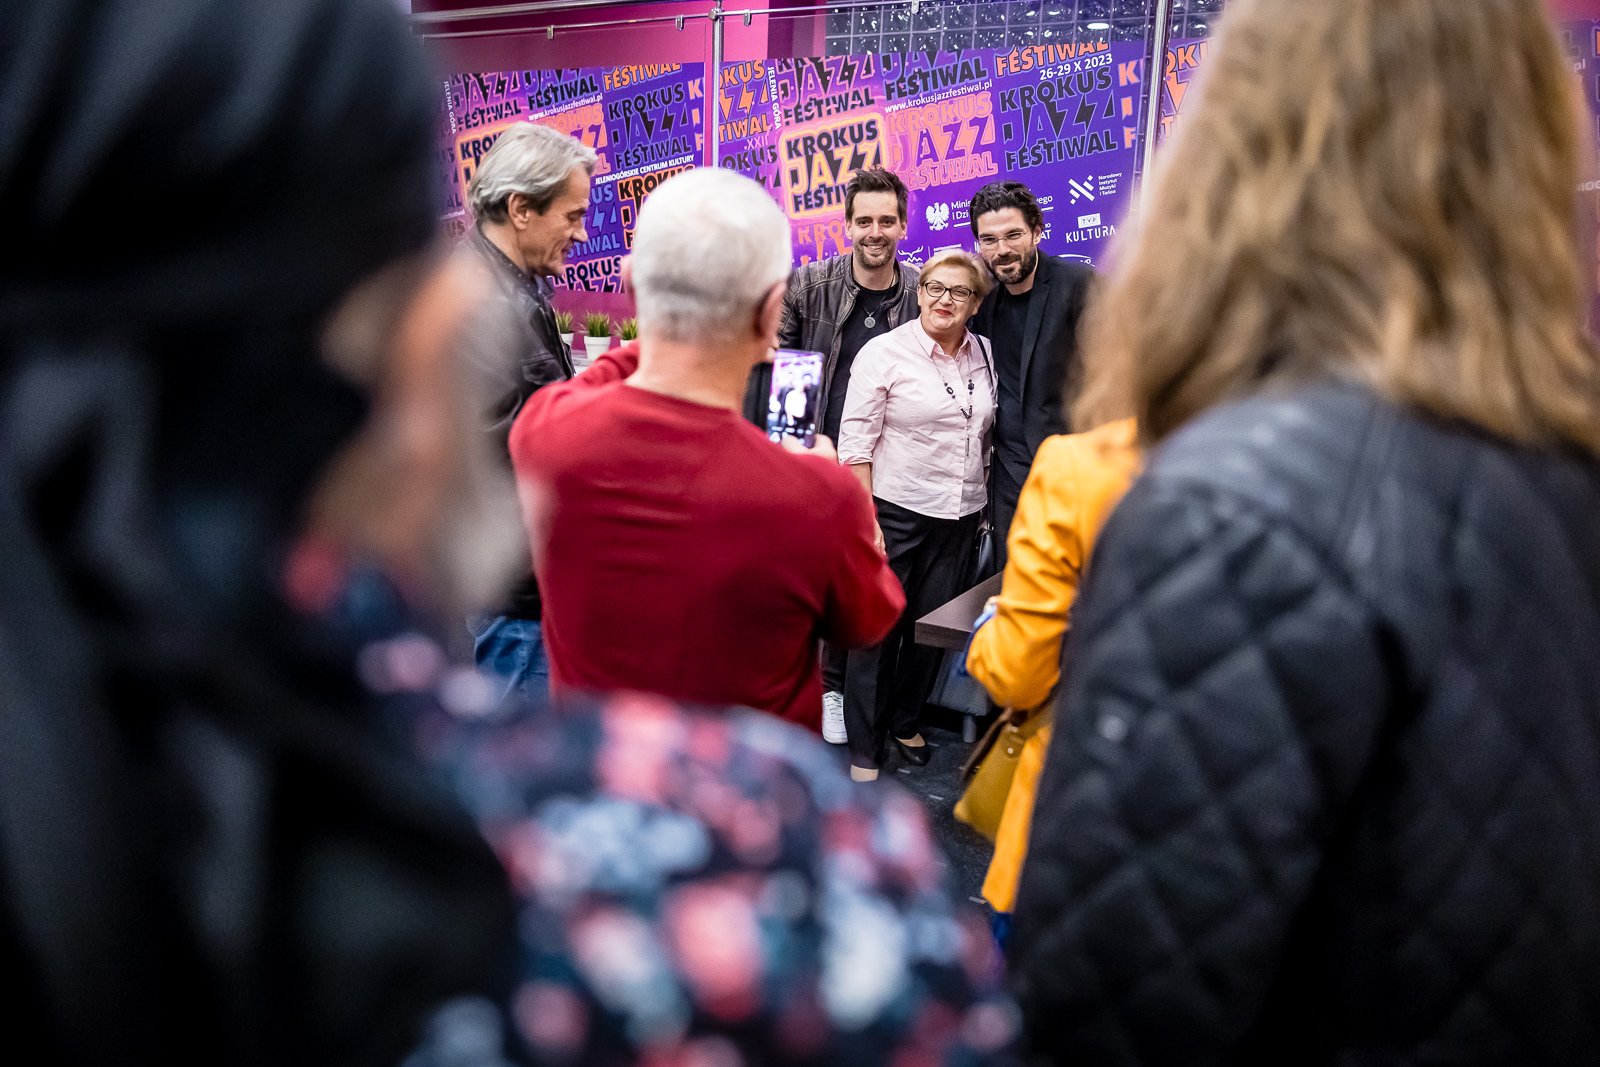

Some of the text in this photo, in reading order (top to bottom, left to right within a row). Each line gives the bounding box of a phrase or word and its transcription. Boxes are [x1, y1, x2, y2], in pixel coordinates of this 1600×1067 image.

[604, 63, 681, 91] FESTIWAL
[885, 57, 988, 102] FESTIWAL
[1040, 53, 1113, 80] 26-29 X 2023
[528, 76, 599, 111] FESTIWAL
[609, 83, 684, 120] KROKUS
[767, 66, 782, 130] JELENIA GÓRA
[783, 87, 876, 126] FESTIWAL
[885, 79, 993, 113] www.krokusjazzfestiwal.pl
[1000, 66, 1112, 112] KROKUS
[458, 99, 522, 131] FESTIWAL
[611, 103, 689, 149] JAZZ
[887, 92, 993, 135] KROKUS
[1001, 90, 1116, 148] JAZZ
[615, 136, 692, 170] FESTIWAL
[722, 144, 778, 172] OKUS
[786, 119, 879, 160] KROKUS
[1006, 128, 1119, 172] FESTIWAL
[640, 161, 669, 175] CENTRUM
[668, 154, 695, 168] KULTURY
[1065, 225, 1116, 244] KULTURA
